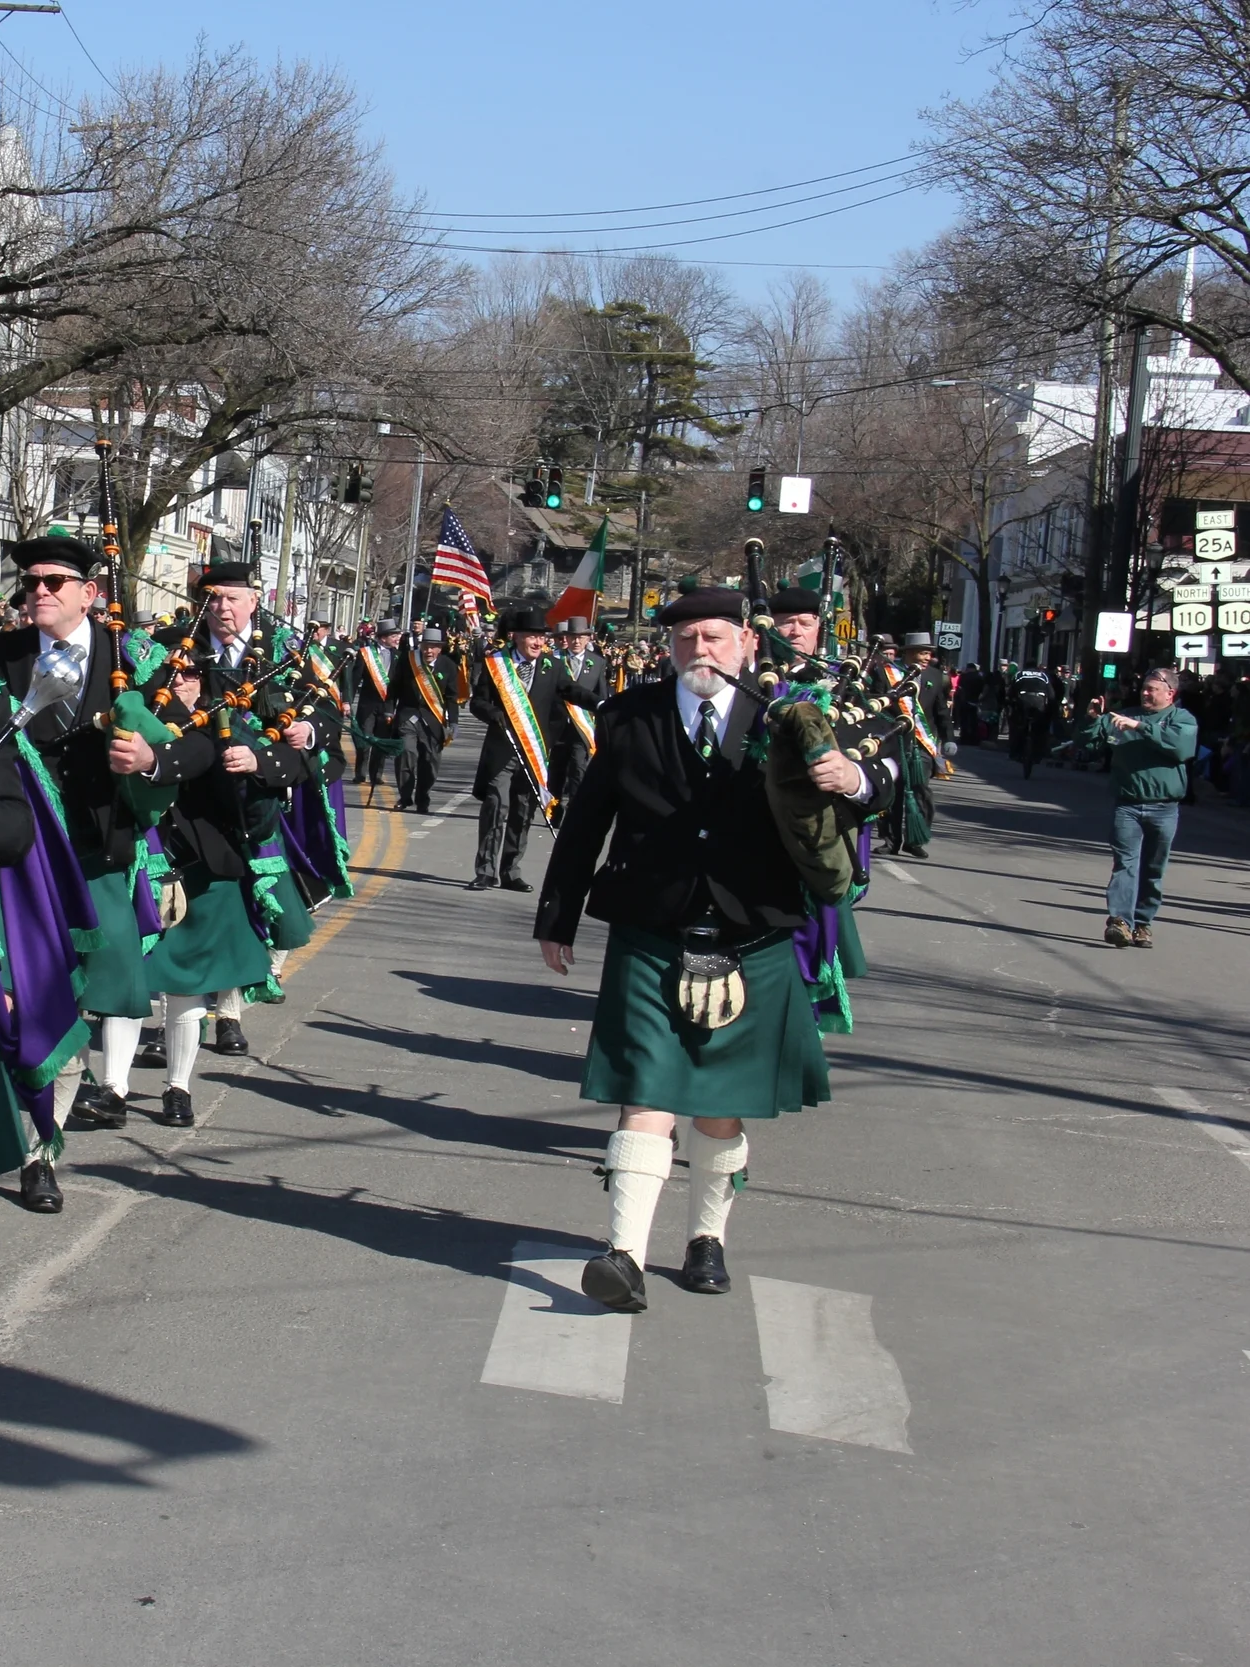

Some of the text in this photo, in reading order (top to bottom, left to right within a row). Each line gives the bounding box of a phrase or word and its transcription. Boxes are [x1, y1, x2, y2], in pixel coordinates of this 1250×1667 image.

[1203, 515, 1228, 525] EAST
[1198, 538, 1233, 553] 25A
[1176, 586, 1208, 599] NORTH
[1179, 611, 1206, 627] 110
[1225, 610, 1250, 625] 110
[940, 636, 960, 647] 25A
